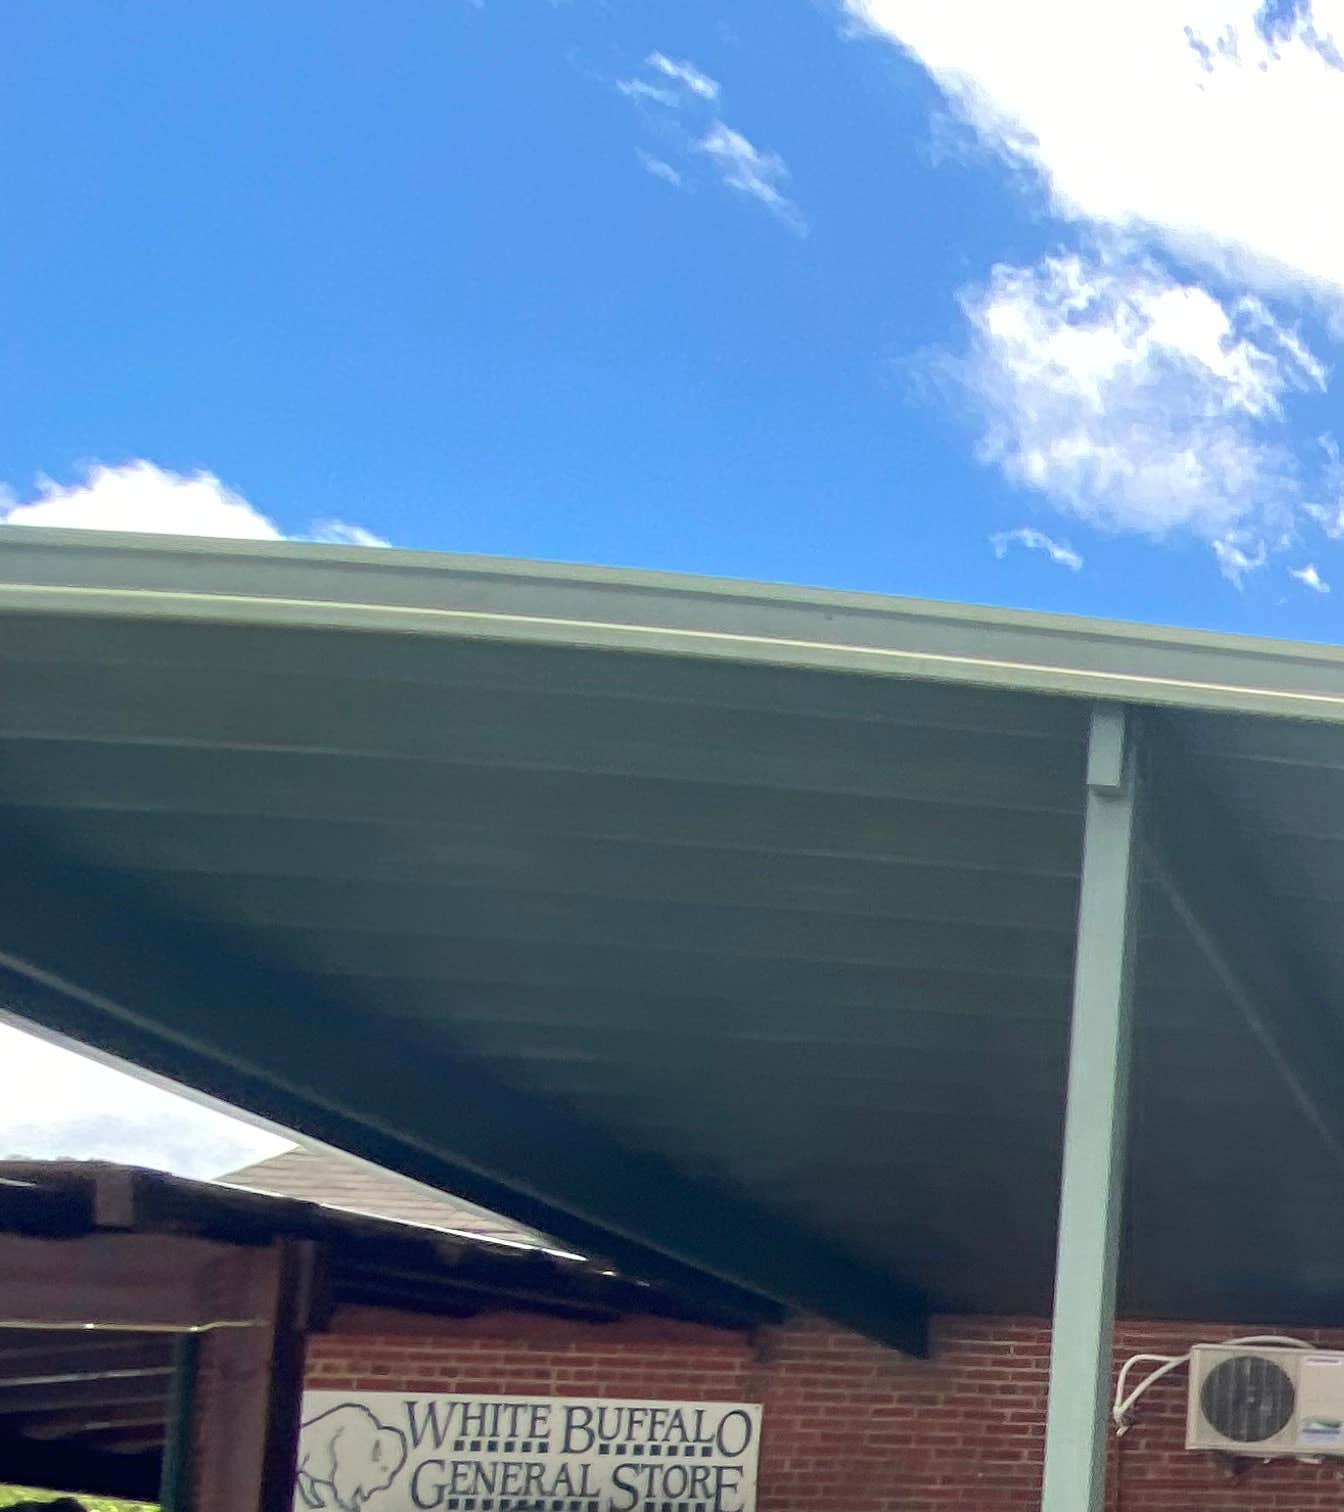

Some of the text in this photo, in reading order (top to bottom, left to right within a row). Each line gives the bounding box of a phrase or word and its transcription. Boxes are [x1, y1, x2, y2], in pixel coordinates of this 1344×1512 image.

[406, 1401, 752, 1457] WHITE BUFFALO
[411, 1459, 601, 1509] GENERAL
